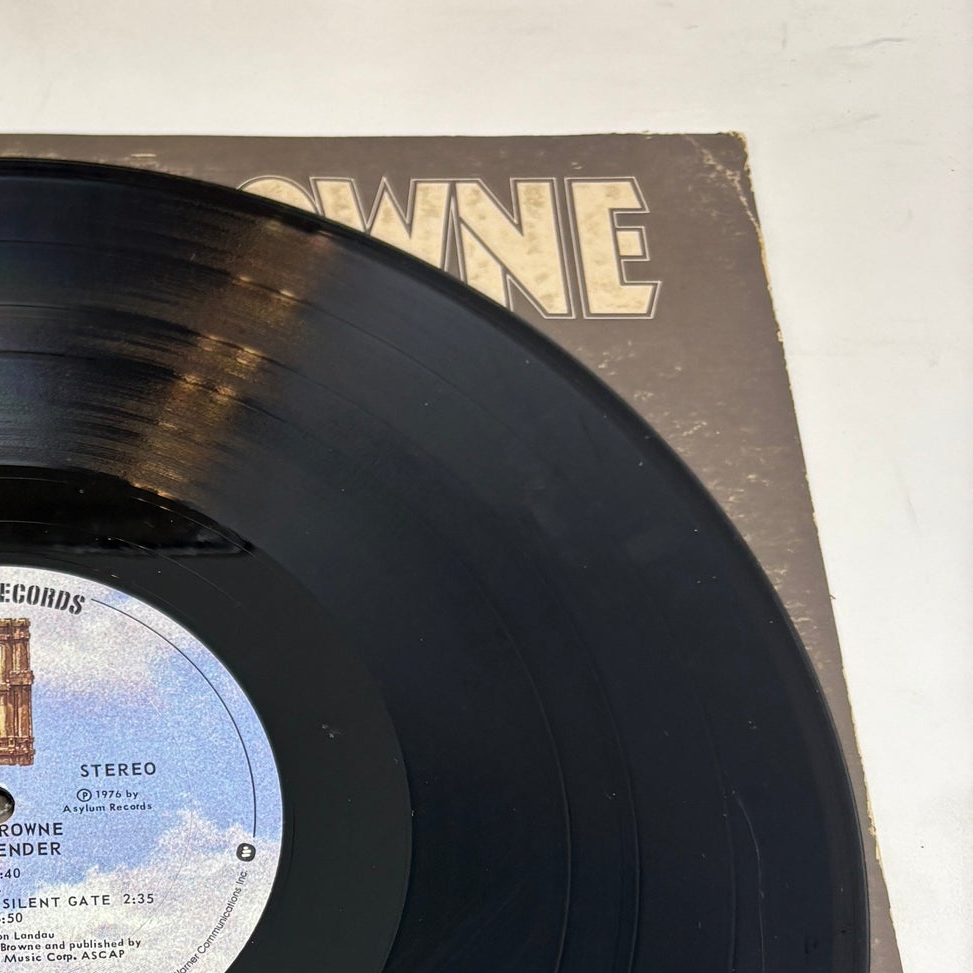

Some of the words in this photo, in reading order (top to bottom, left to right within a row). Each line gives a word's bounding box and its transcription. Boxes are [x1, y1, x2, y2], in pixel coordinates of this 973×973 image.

[80, 762, 156, 777] STEREO
[96, 790, 121, 798] 1976
[126, 789, 139, 800] by
[63, 803, 105, 814] Asylum
[109, 802, 152, 812] Records
[3, 897, 60, 909] SILENT
[68, 895, 111, 907] GATE
[123, 894, 154, 905] 2:35
[197, 887, 242, 954] Communications
[14, 931, 55, 940] Landau
[1, 943, 41, 952] Browne
[45, 941, 65, 950] and
[69, 939, 124, 952] published
[128, 939, 141, 948] by
[4, 954, 41, 963] Music
[47, 953, 76, 964] Corp.
[81, 950, 125, 960] ASCAP
